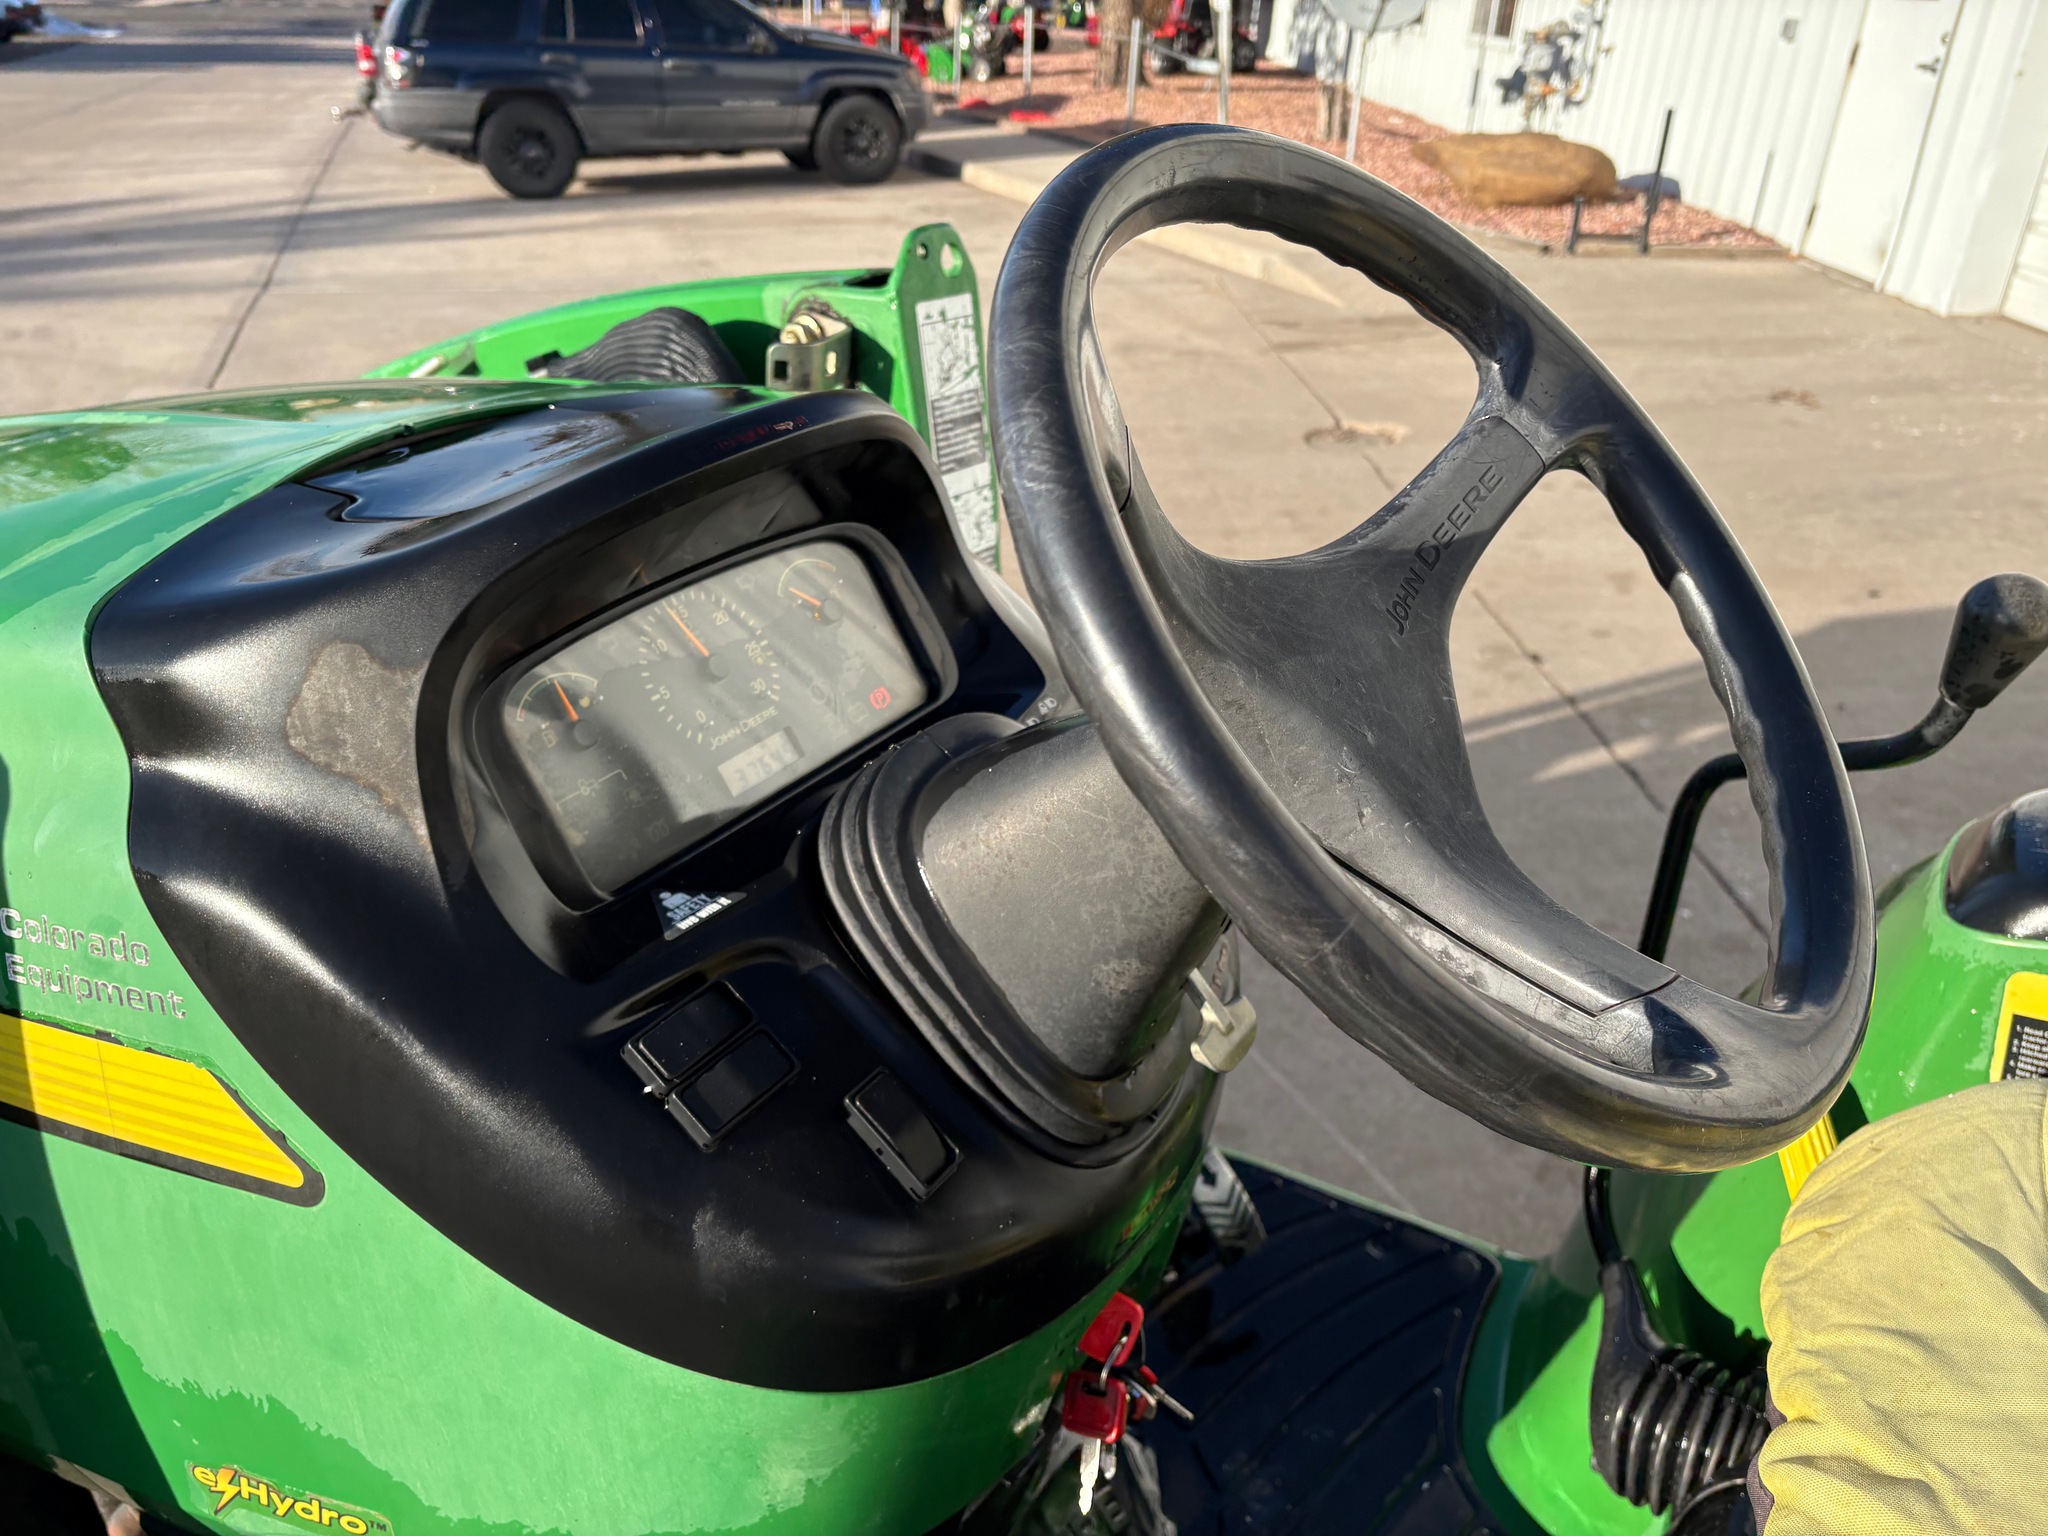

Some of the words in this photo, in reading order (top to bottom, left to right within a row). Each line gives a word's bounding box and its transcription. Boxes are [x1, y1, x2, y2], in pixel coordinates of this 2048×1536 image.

[1386, 567, 1425, 636] JOHN
[1415, 465, 1503, 572] DEERE
[713, 609, 730, 626] 20
[651, 639, 668, 655] 10
[744, 641, 762, 657] 25
[659, 685, 671, 700] 5
[750, 678, 767, 695] 30
[696, 710, 707, 723] 0
[710, 725, 741, 751] JOHN
[740, 706, 778, 732] DEERE
[666, 893, 712, 921] SAFETY
[0, 907, 150, 967] Colorado
[5, 952, 187, 1019] Equipment
